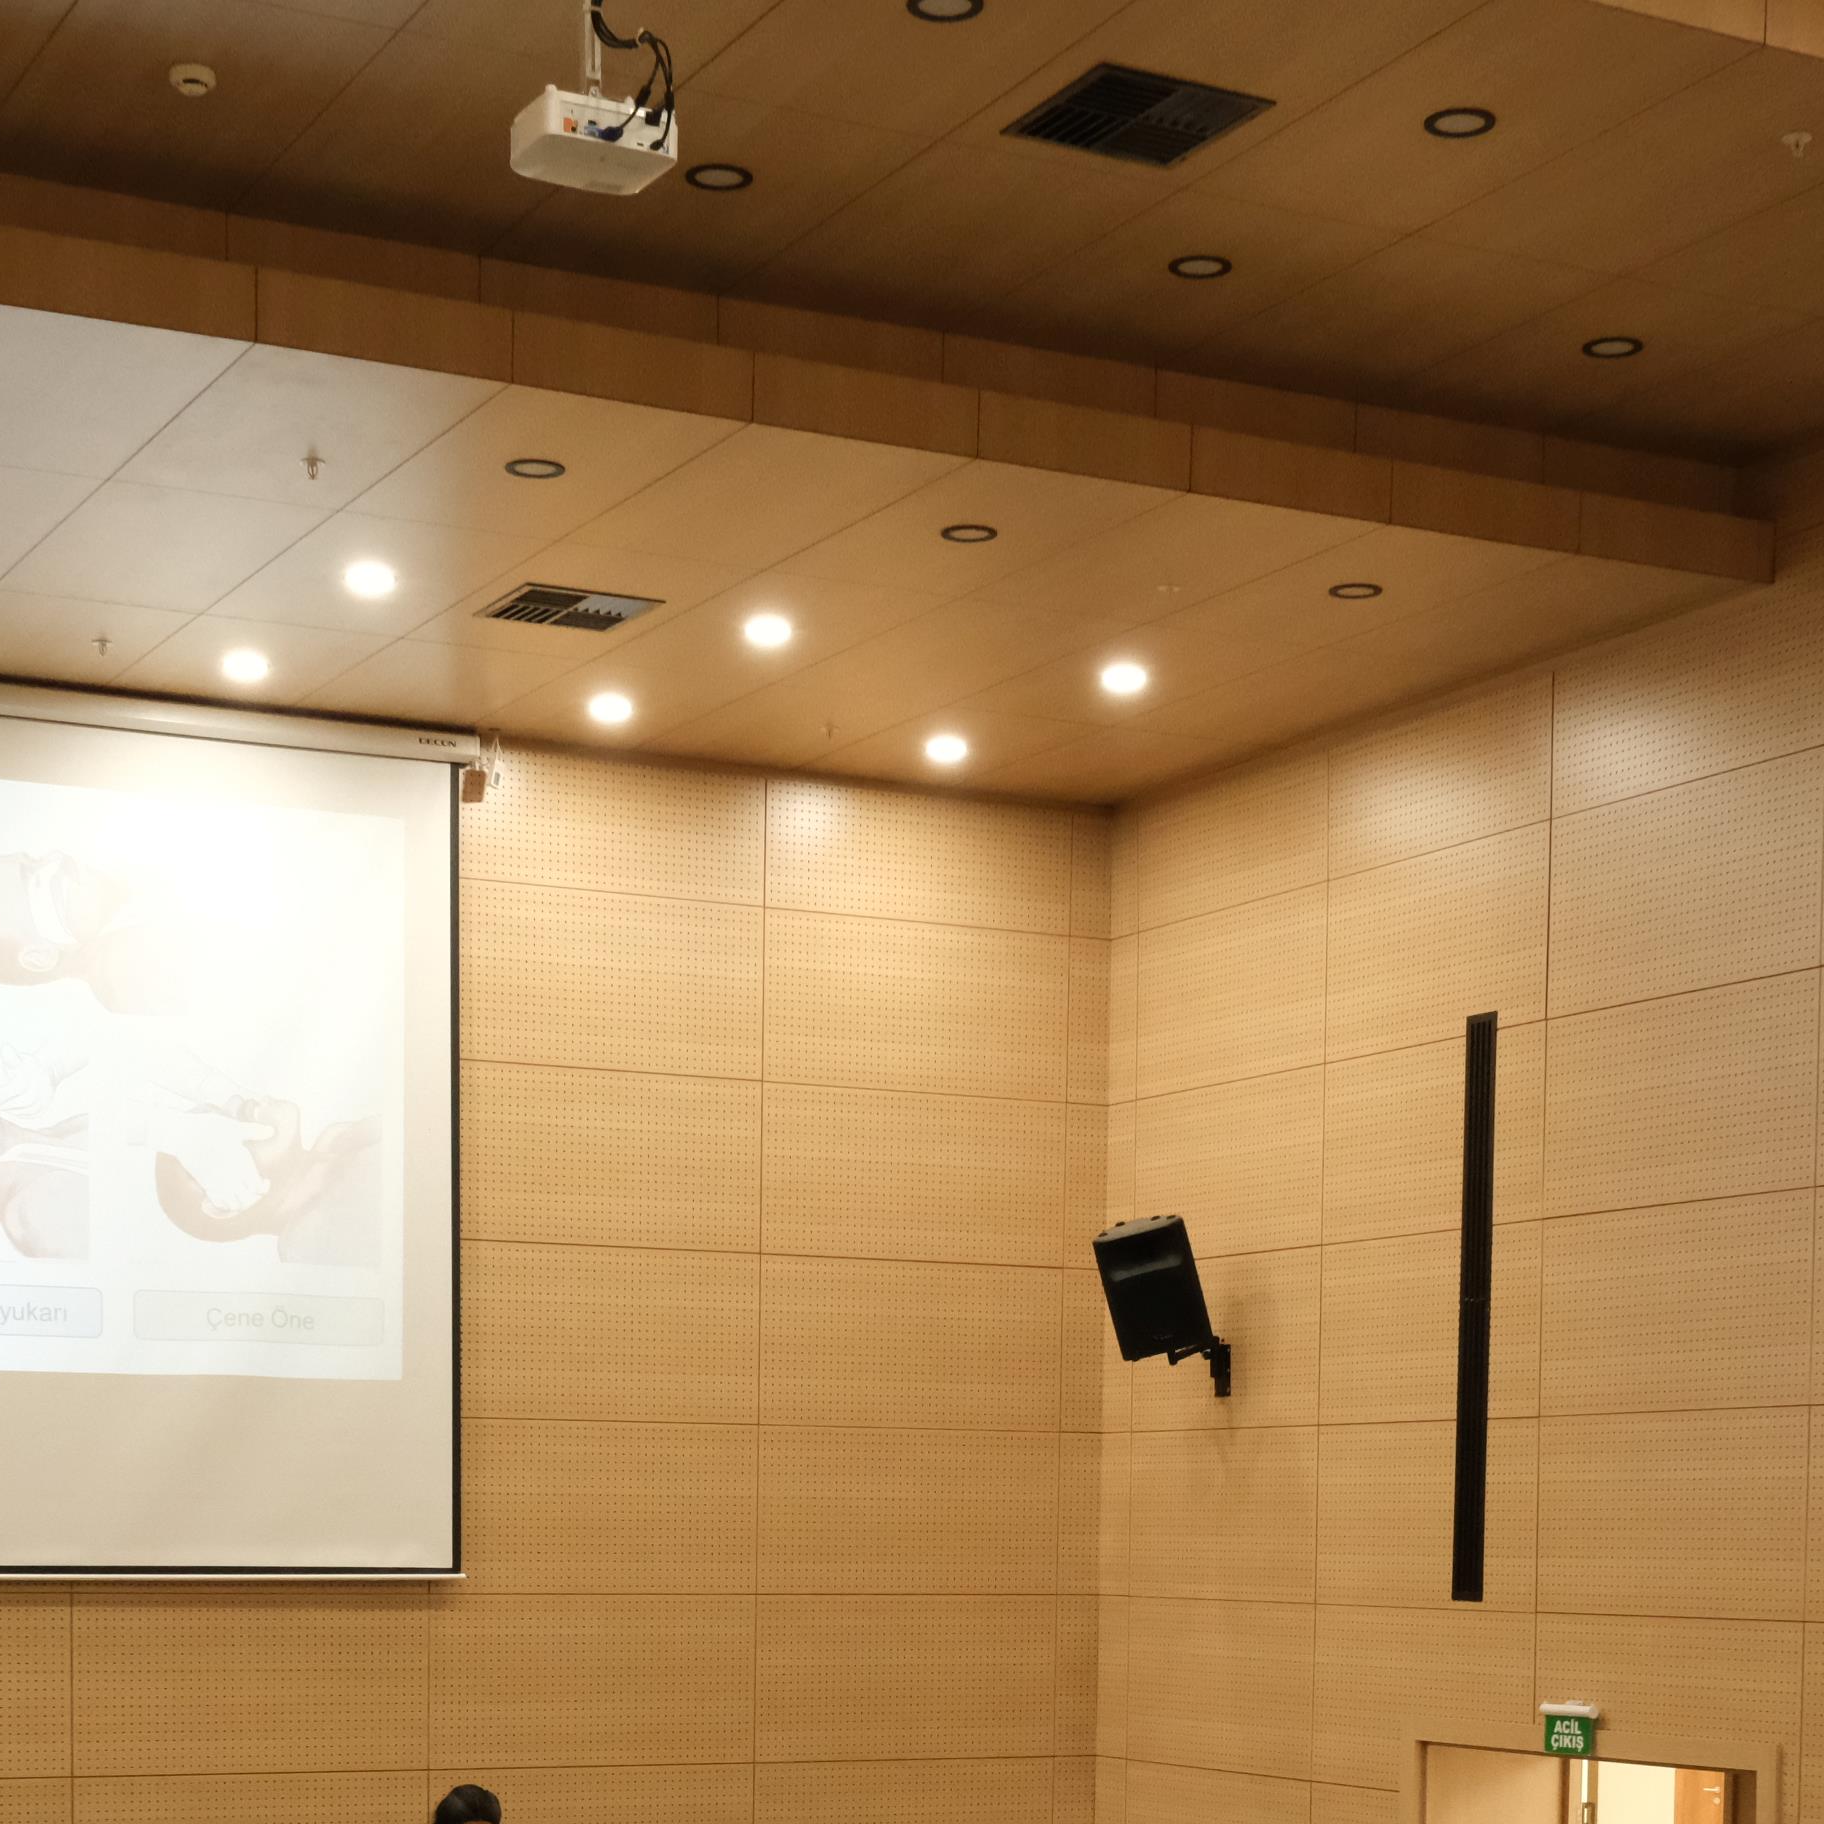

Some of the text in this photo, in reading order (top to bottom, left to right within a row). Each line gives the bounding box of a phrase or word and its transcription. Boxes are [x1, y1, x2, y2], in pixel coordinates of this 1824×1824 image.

[0, 1301, 68, 1325] yukarı
[206, 1304, 315, 1331] Çene Öne
[1553, 1718, 1582, 1735] ACİL
[1550, 1734, 1584, 1753] ÇIKIŞ
